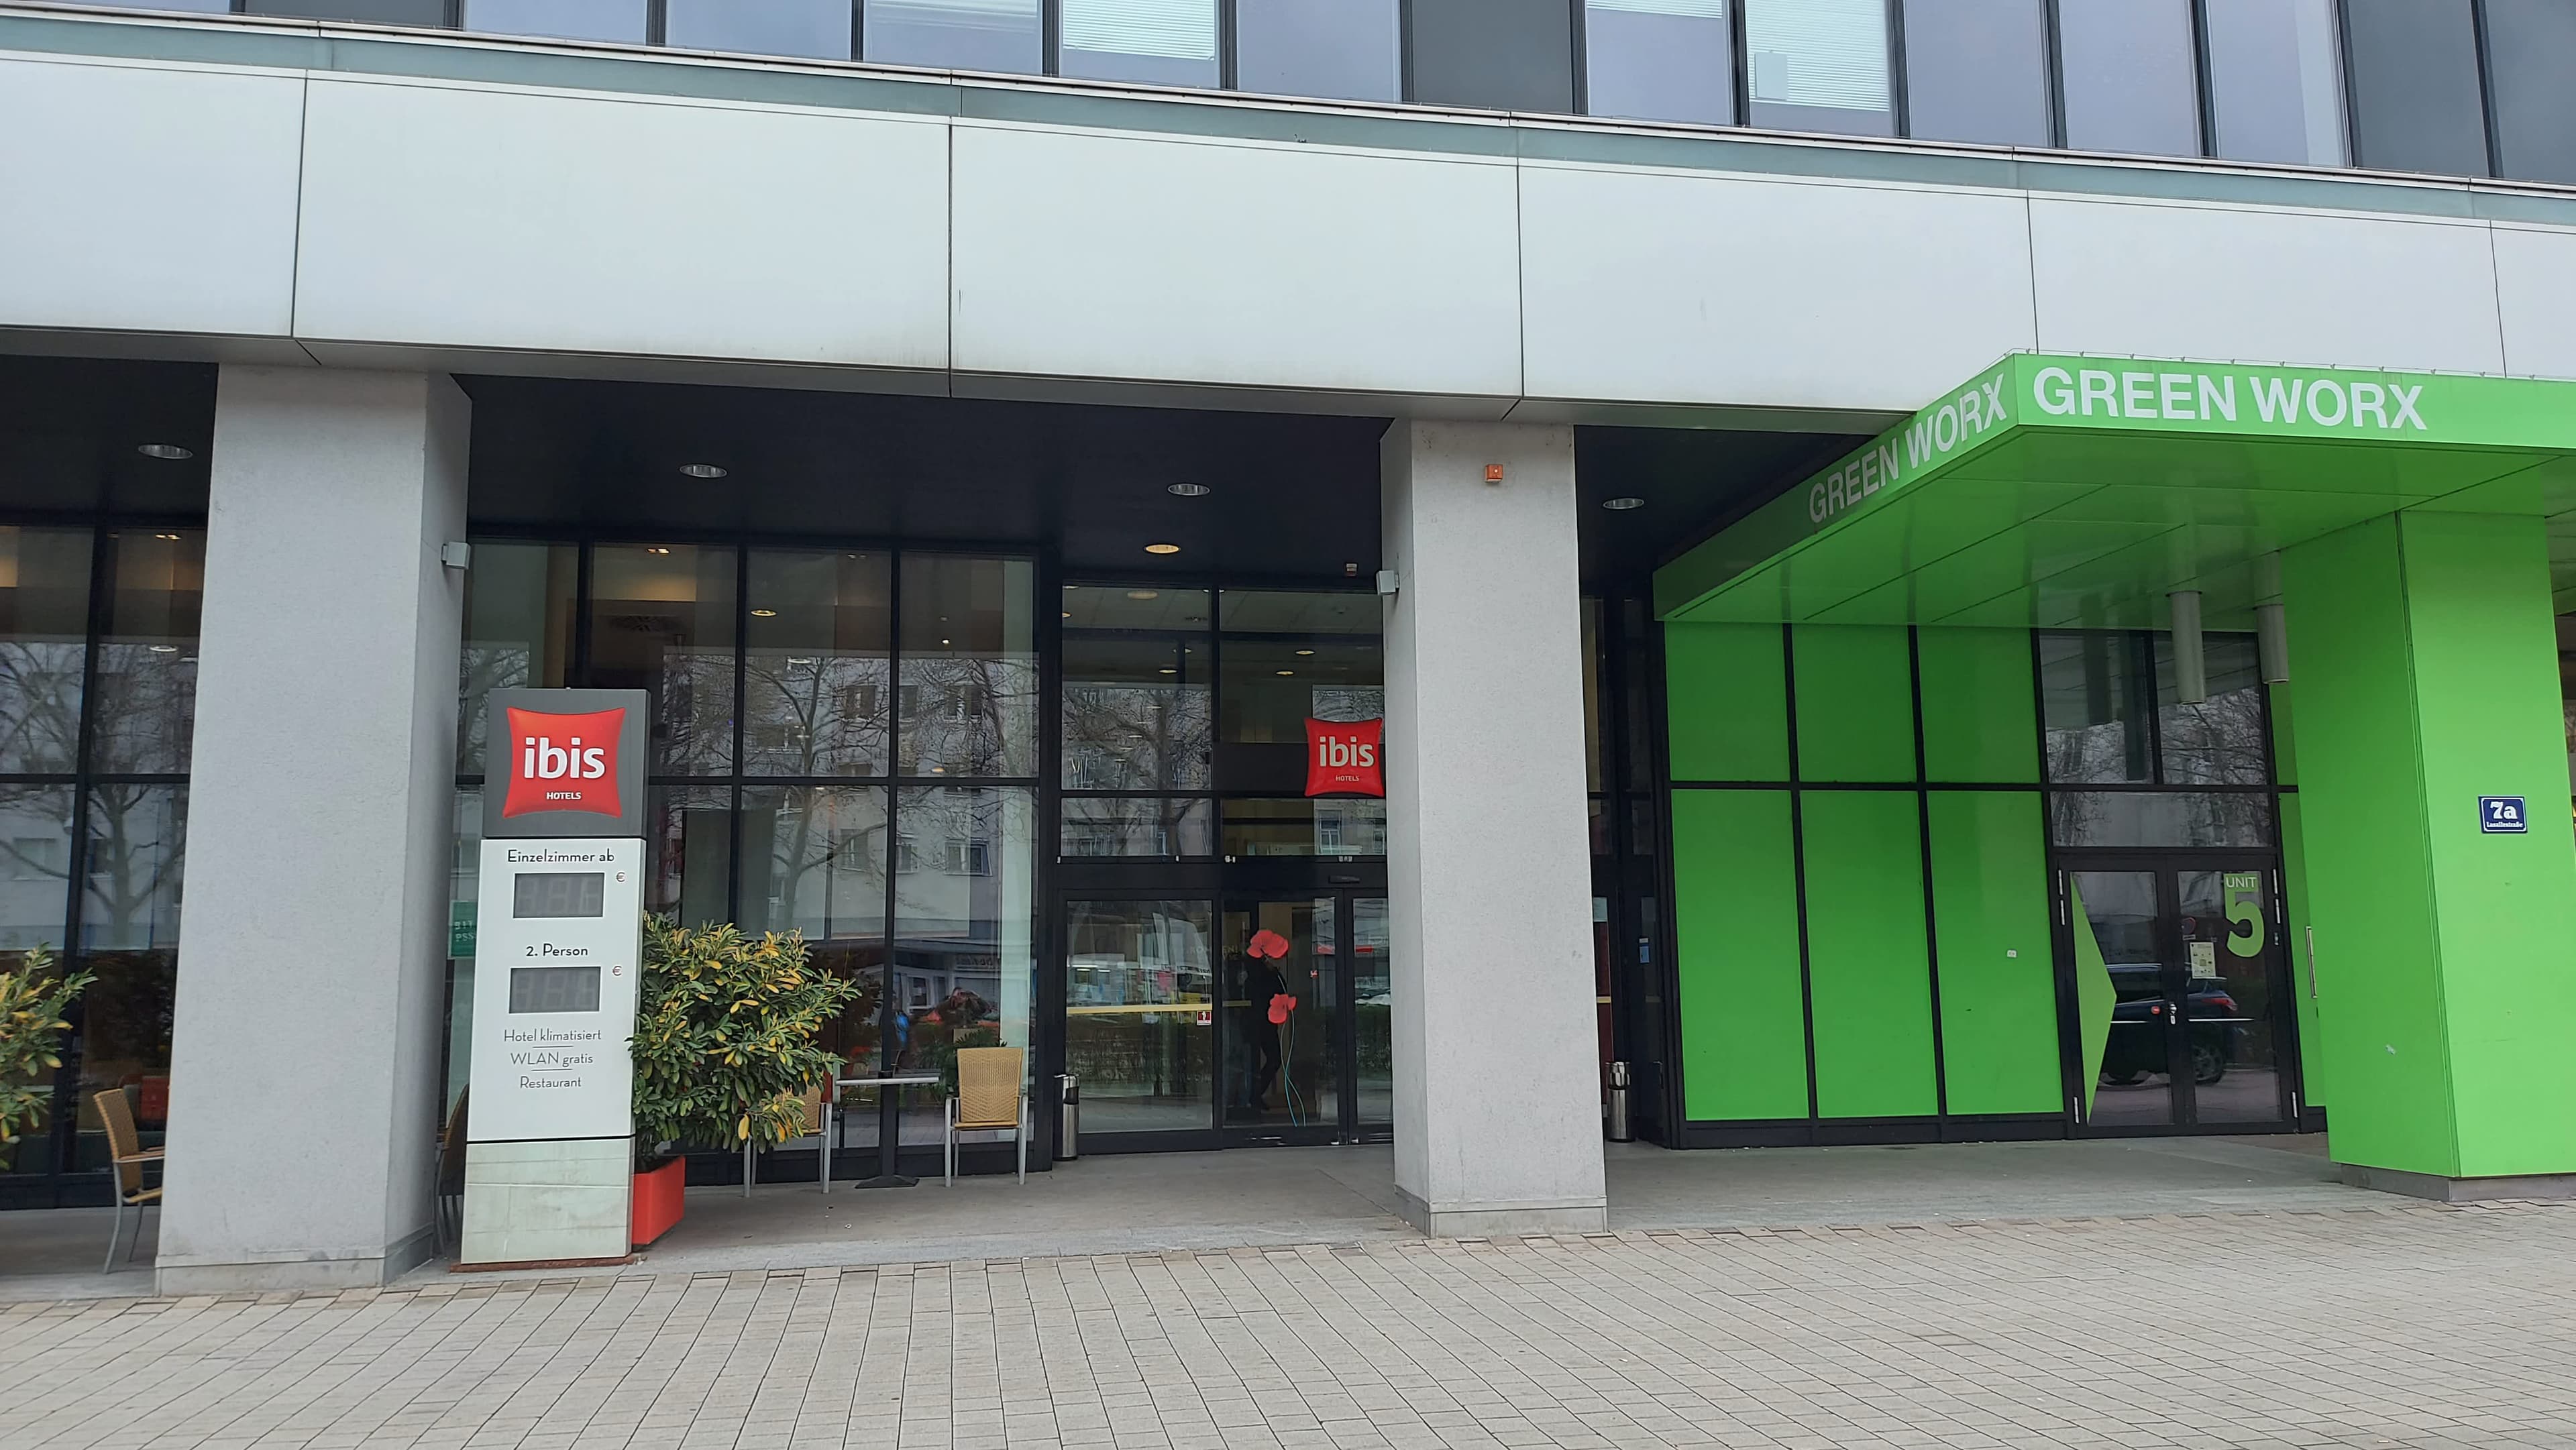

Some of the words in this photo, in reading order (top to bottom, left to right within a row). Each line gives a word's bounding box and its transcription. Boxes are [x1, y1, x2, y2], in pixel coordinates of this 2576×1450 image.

[2033, 367, 2237, 422] GREEN
[2249, 377, 2428, 430] WORX
[1809, 438, 1900, 523] GREEN
[1904, 373, 2007, 469] WORX
[523, 736, 606, 779] ibis
[1320, 736, 1375, 767] ibis
[2490, 801, 2518, 819] 7a
[507, 848, 595, 862] Einzelzimmer
[599, 848, 615, 862] ab
[616, 872, 625, 882] €
[2225, 877, 2257, 888] UNIT
[2223, 873, 2265, 958] 5
[525, 946, 538, 956] 2.
[543, 943, 588, 956] Person
[612, 966, 622, 976] €
[504, 1028, 537, 1042] Hotel
[540, 1027, 602, 1041] klimatisiert
[510, 1052, 559, 1065] WLAN
[562, 1053, 594, 1068] gratis
[520, 1076, 582, 1089] Restaurant
